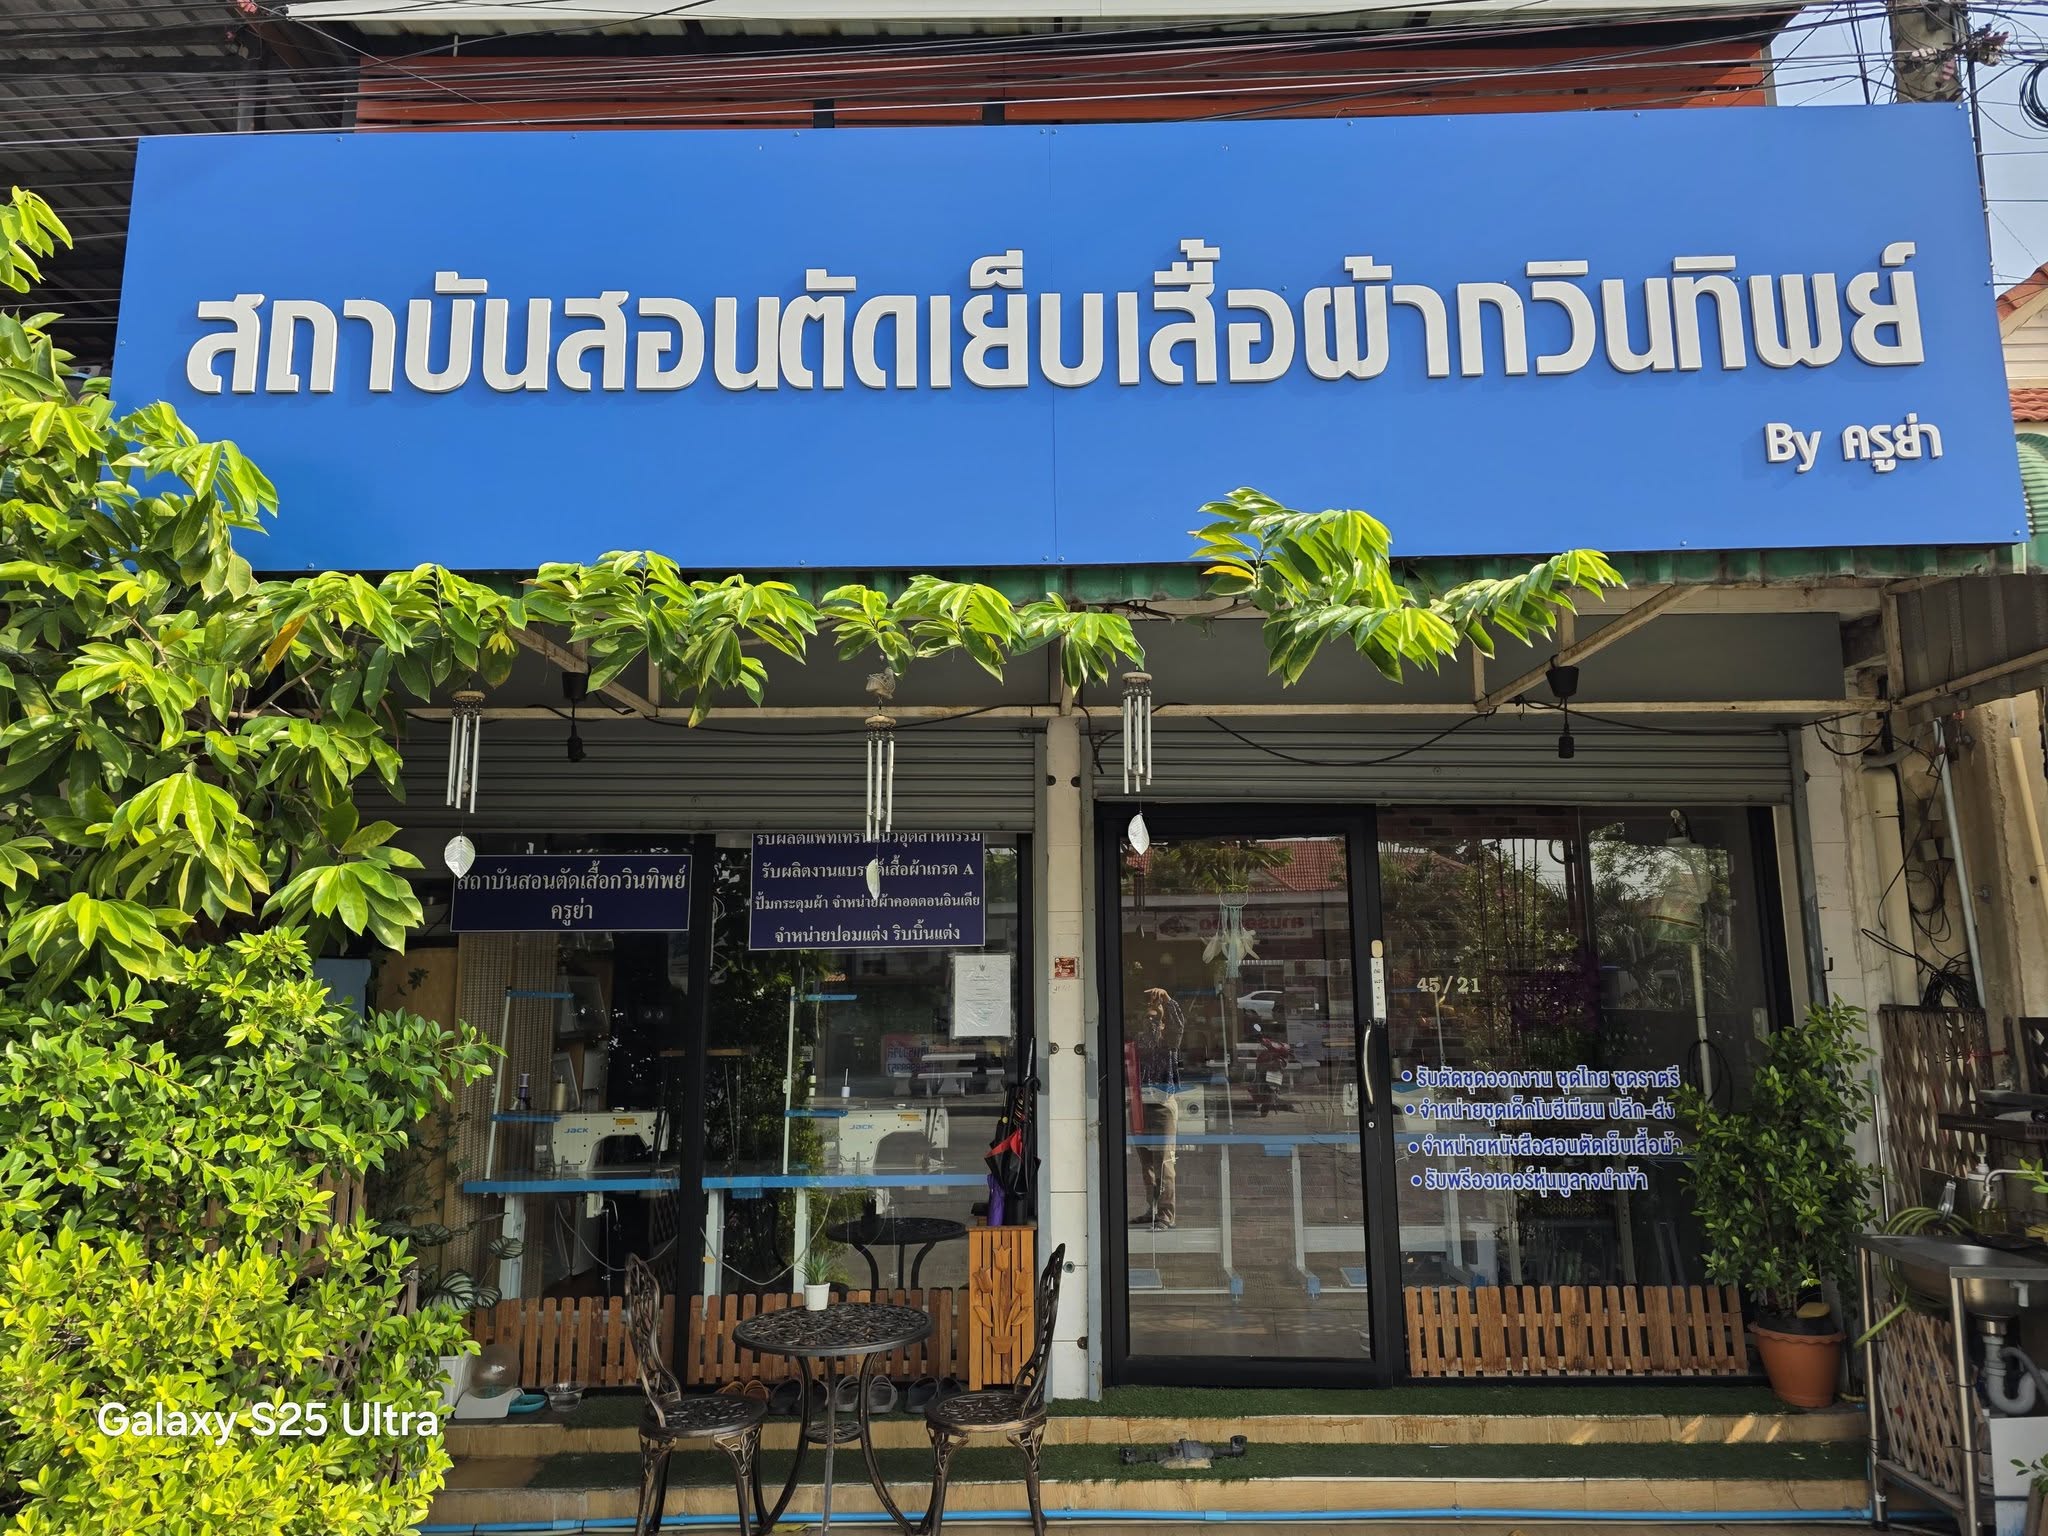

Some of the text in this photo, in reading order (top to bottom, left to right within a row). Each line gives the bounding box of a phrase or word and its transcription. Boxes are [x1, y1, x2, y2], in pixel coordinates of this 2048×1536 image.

[186, 239, 1925, 394] สถาบันสอนตัดเย็บเสื้อผ้ากวินทิพย์
[1765, 412, 1943, 473] By ครูย่า
[457, 860, 686, 890] สถาบันสอนตัดเสื้อกวินทิพย์
[761, 854, 975, 879] รับผลิตงานแบรด์เสื้อผ้าเกรด A
[551, 898, 593, 926] ครูย่า
[774, 918, 960, 943] จำหน่ายปอมแต่ง ริบบิ้นแต่ง
[1416, 1065, 1680, 1094] รับตัดชุดออกงาน ชุดไทย ชุดราตรี
[1419, 1095, 1605, 1126] จำหน่ายชุดเด็กโบฮีเมียน
[1425, 1166, 1648, 1198] รับพรีออเดอร์หุ่นมูลาจนำเข้า
